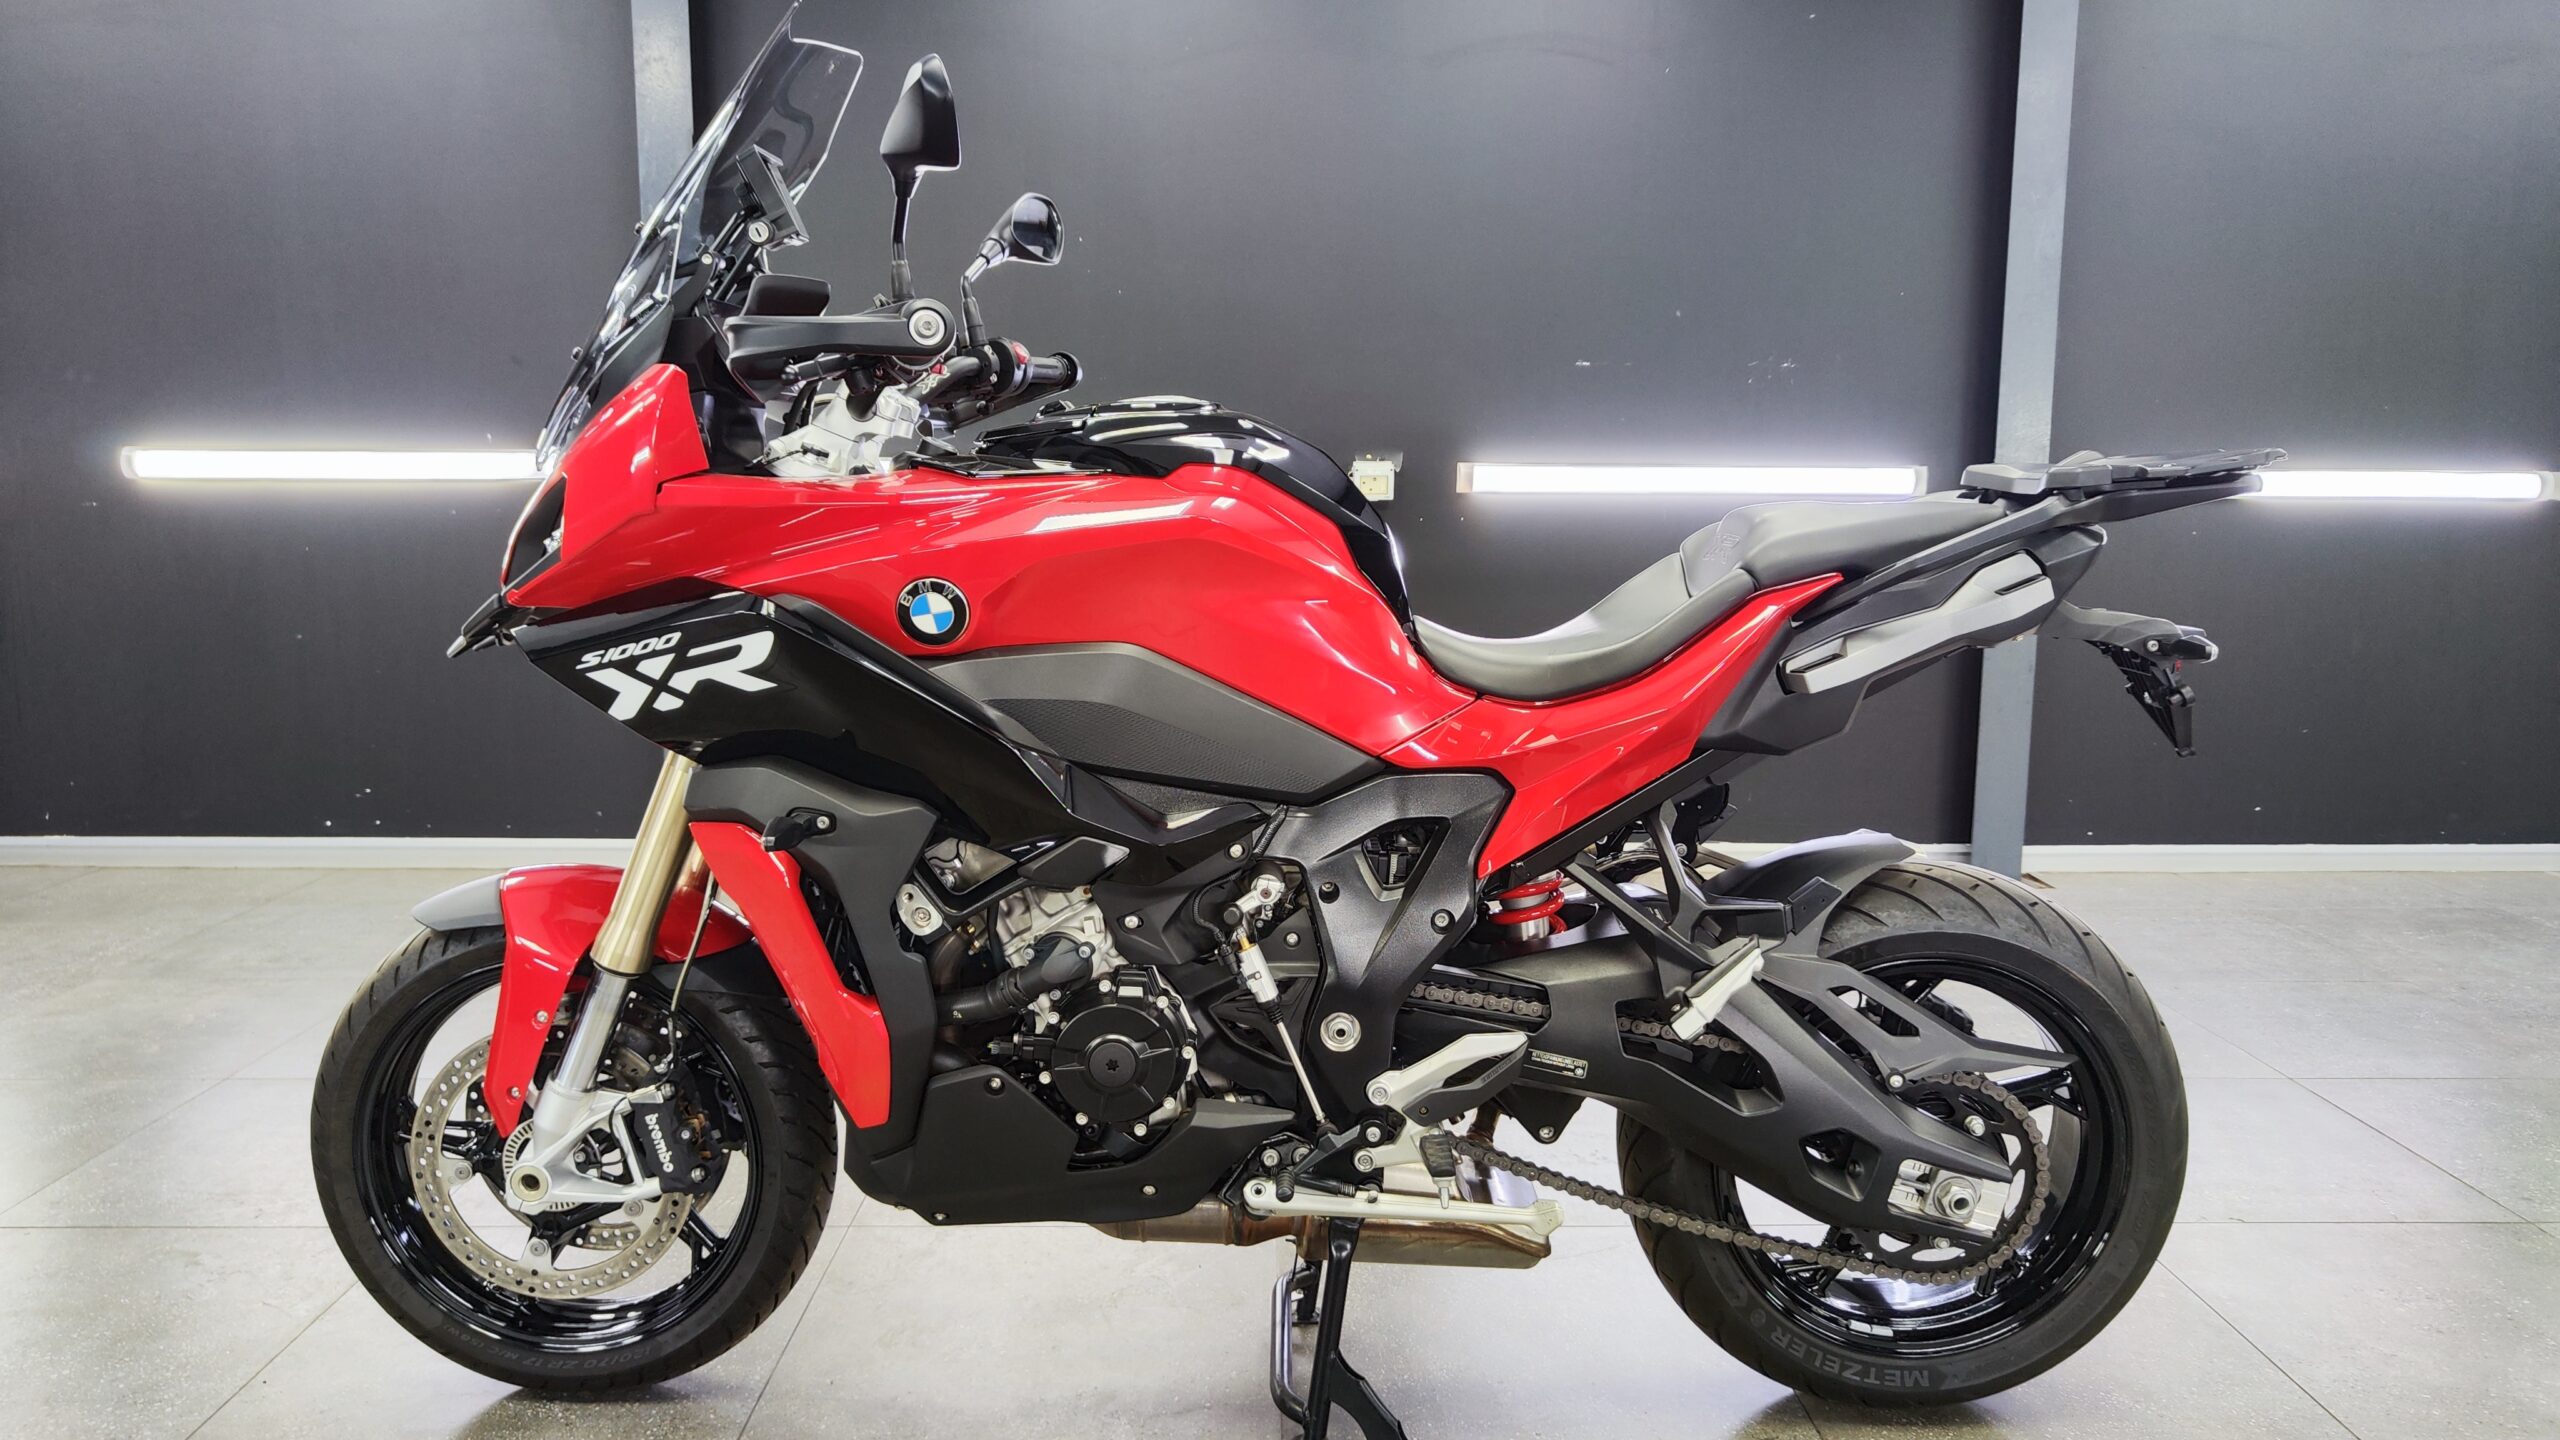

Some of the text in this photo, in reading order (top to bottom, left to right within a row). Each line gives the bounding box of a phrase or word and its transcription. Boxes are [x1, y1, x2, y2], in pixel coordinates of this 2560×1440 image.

[900, 580, 957, 607] BMW
[575, 631, 682, 669] S1000
[585, 630, 778, 721] XR
[644, 1113, 674, 1173] brembo
[1770, 1326, 1930, 1387] METZELER
